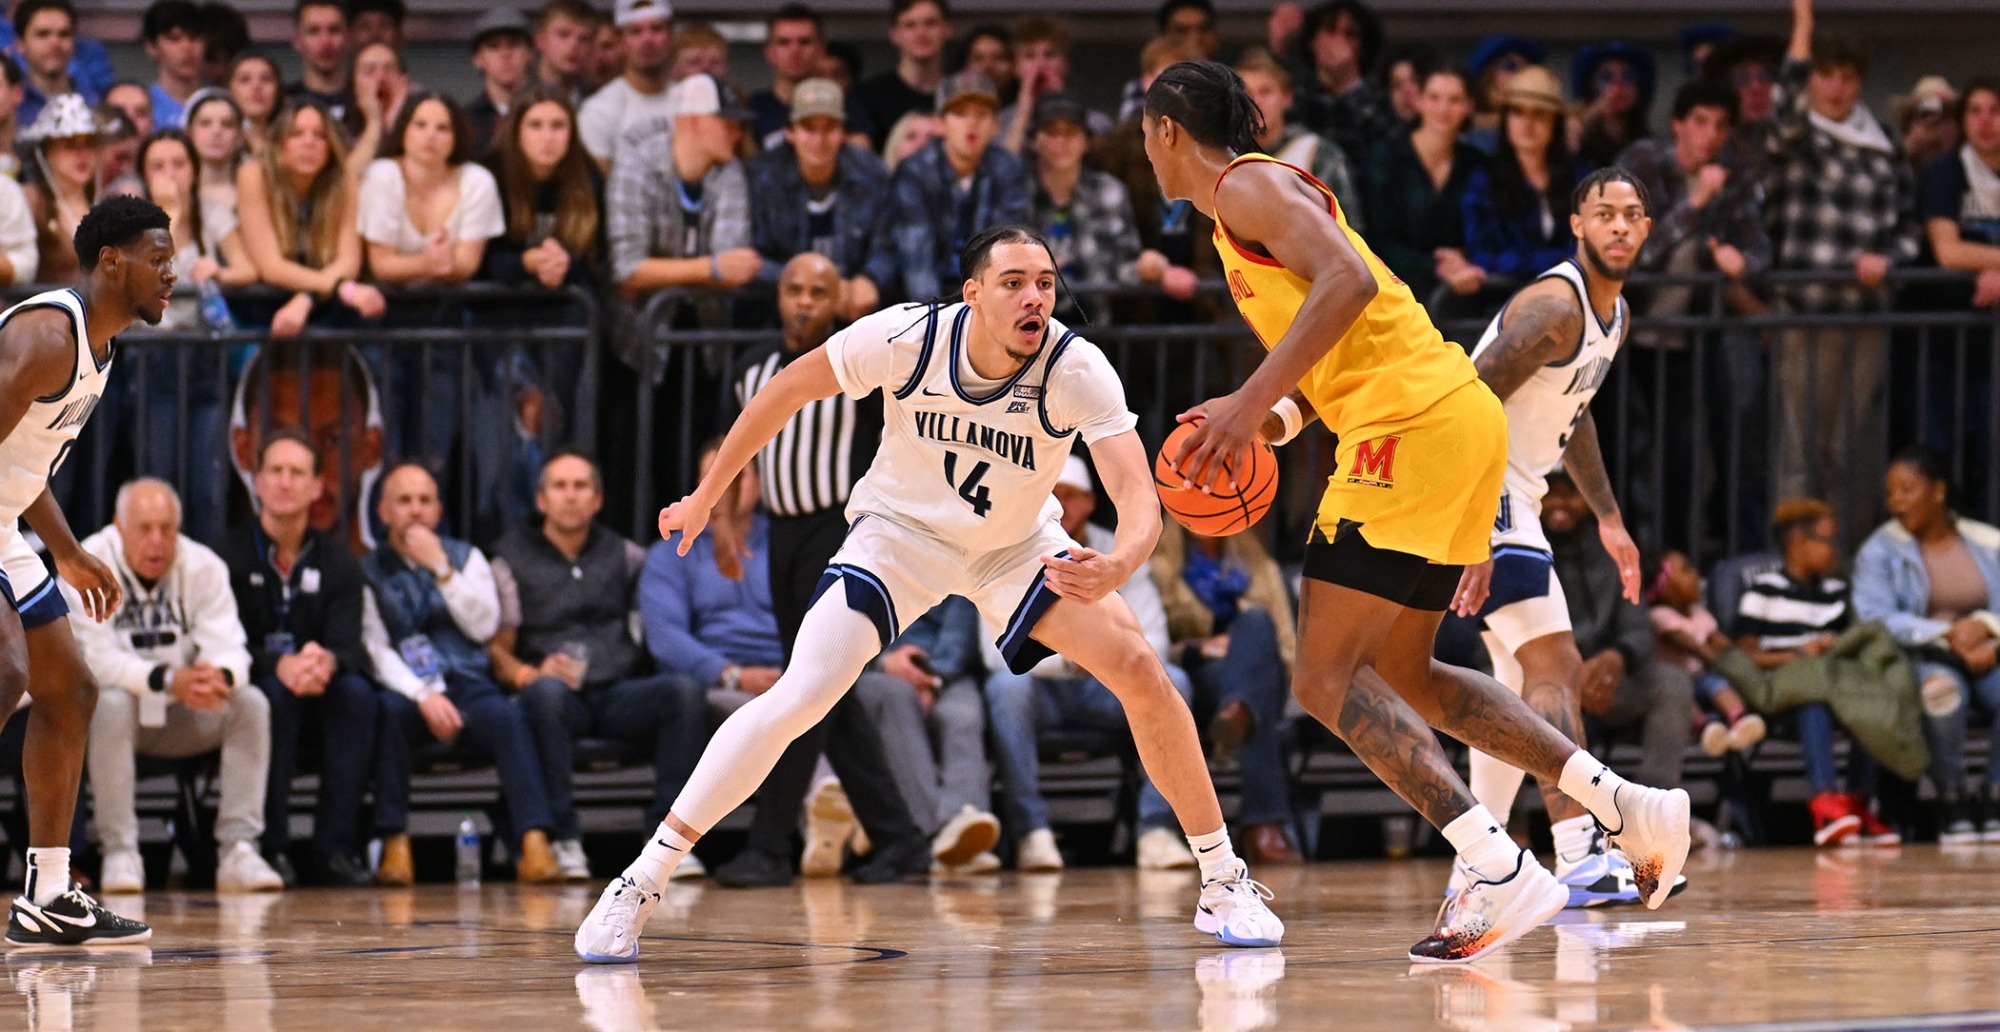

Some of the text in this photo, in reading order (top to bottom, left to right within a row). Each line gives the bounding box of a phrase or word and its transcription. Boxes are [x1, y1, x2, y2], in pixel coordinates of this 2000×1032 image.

[915, 411, 1036, 471] VILLANOVA
[1349, 435, 1401, 482] M
[944, 450, 992, 518] 14
